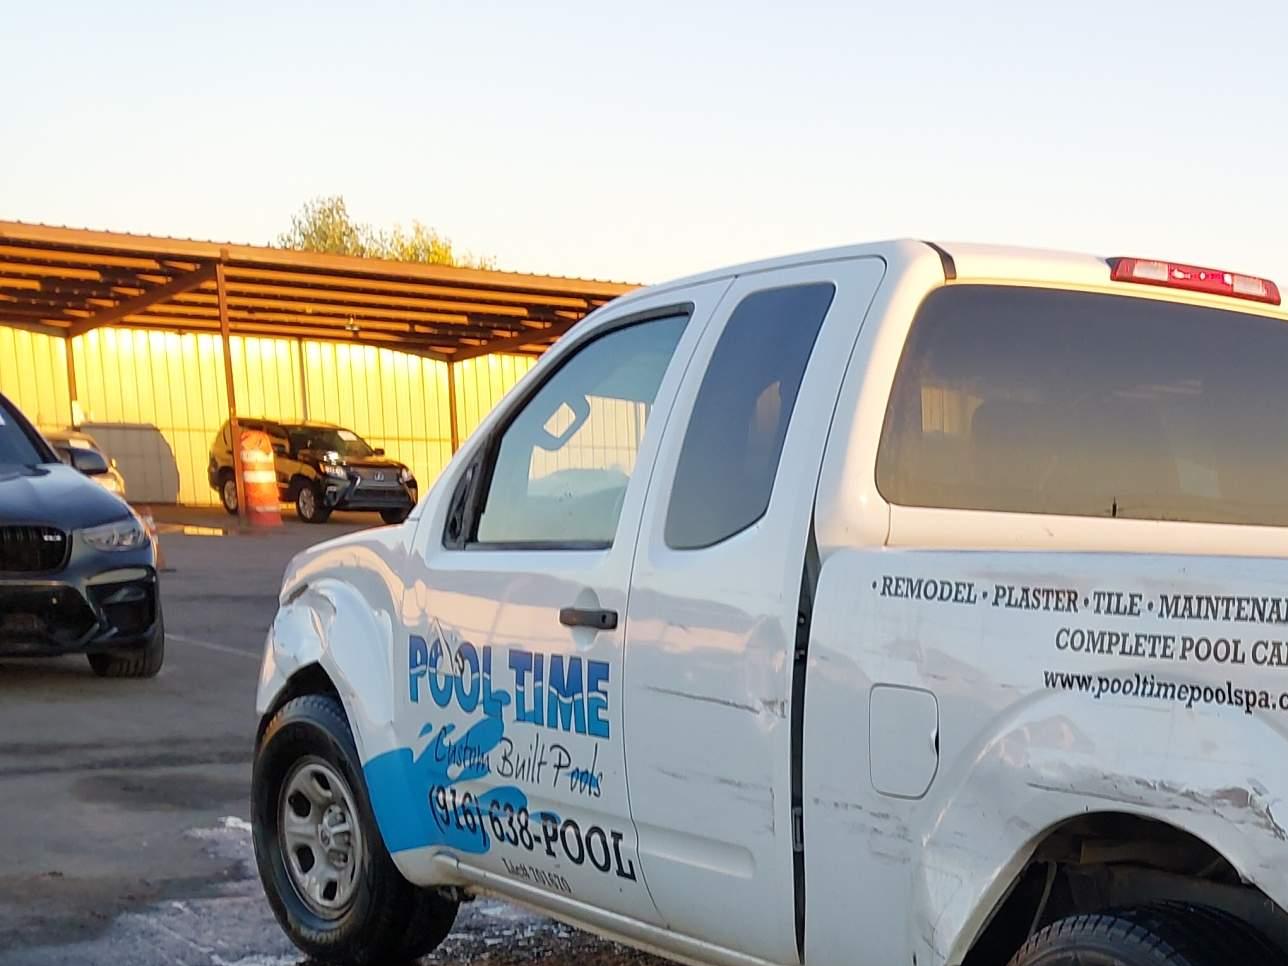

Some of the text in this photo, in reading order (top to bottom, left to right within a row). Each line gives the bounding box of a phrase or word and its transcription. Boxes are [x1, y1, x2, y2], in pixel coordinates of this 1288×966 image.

[879, 576, 977, 604] REMODEL
[991, 584, 1079, 613] PLASTER
[1091, 592, 1142, 617] TILE
[1055, 628, 1176, 660] COMPLETE
[1178, 637, 1246, 665] POOL
[409, 635, 610, 739] POOL TIME
[434, 725, 603, 799] Custom Built Pools
[428, 784, 638, 883] (916) 638-POOL
